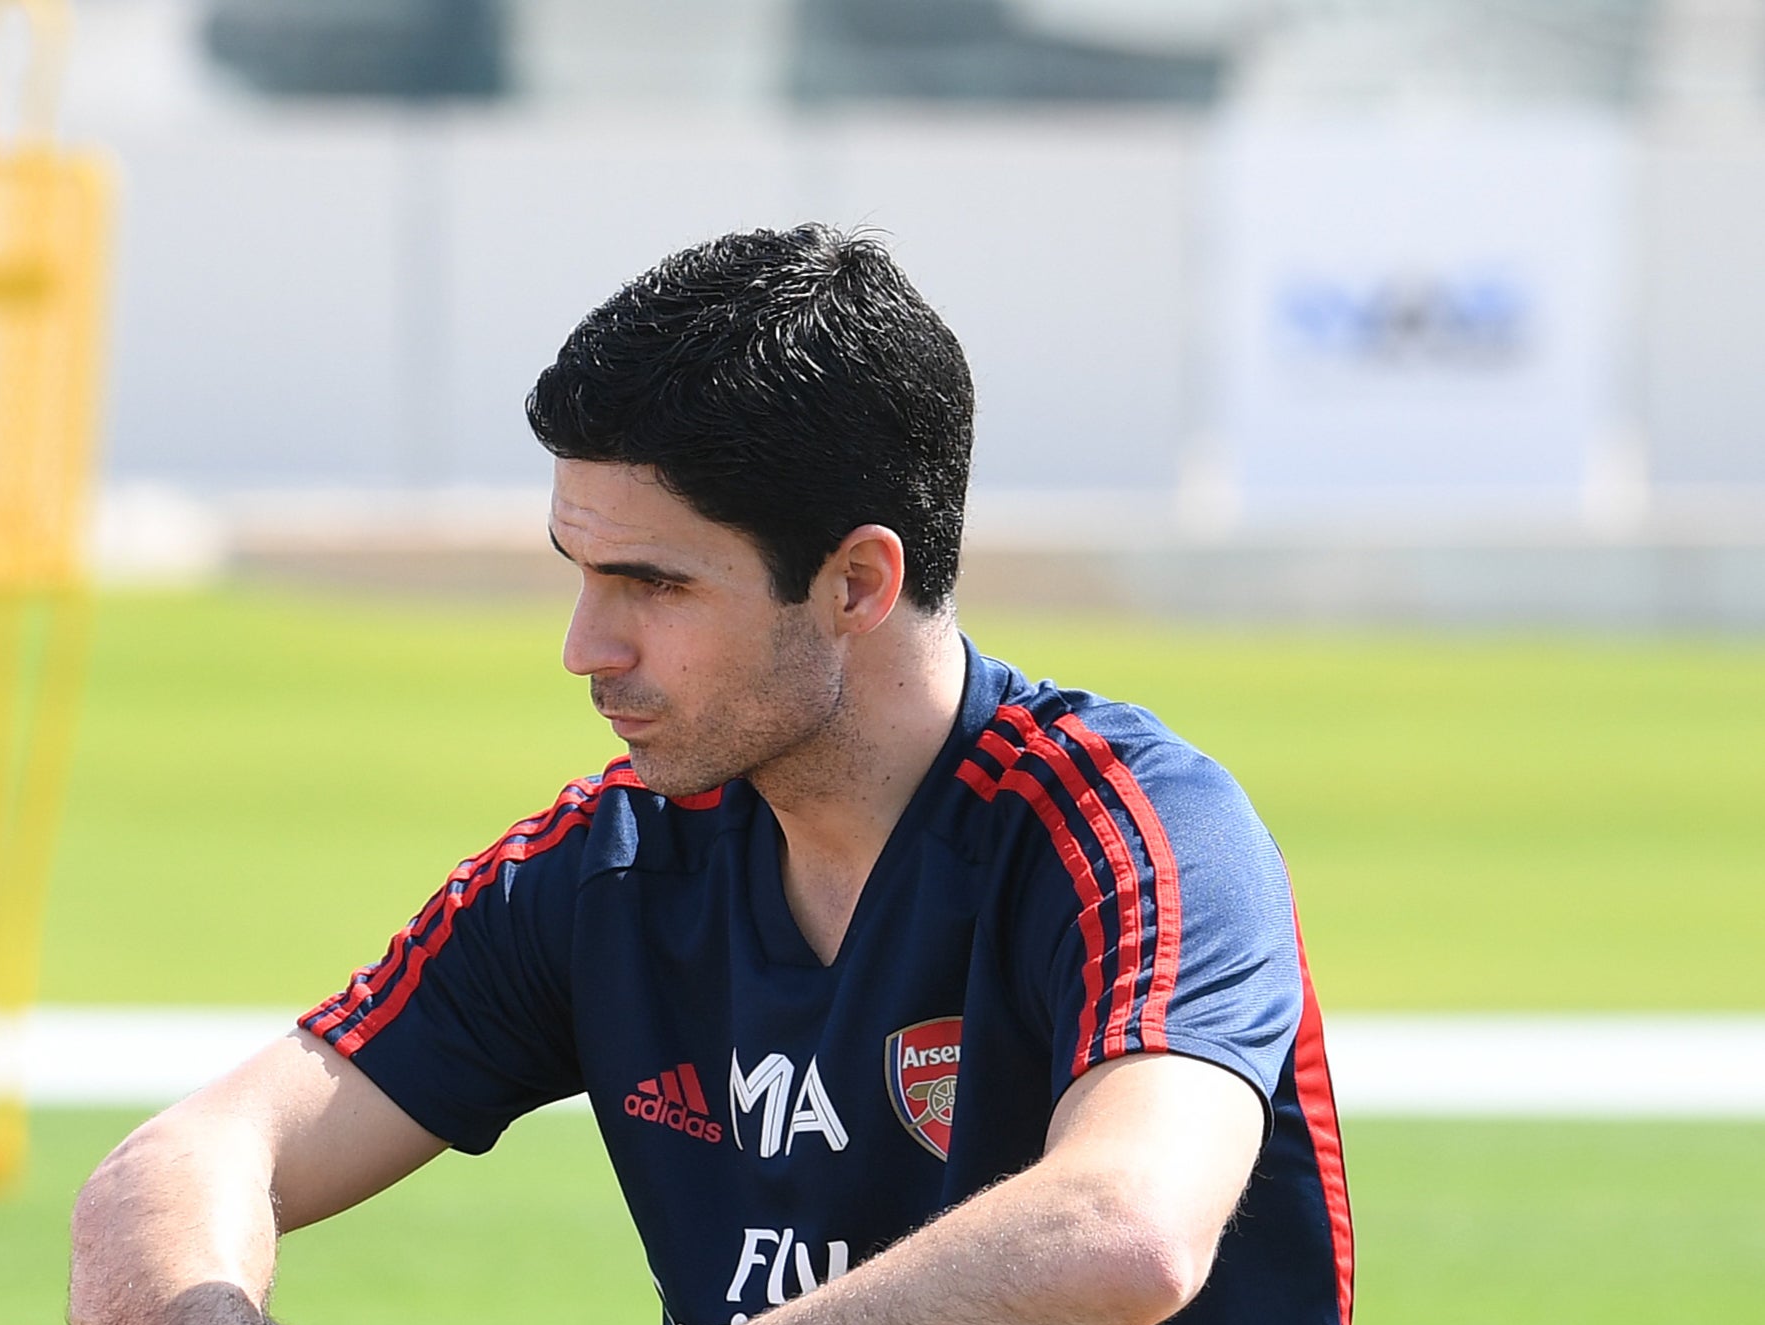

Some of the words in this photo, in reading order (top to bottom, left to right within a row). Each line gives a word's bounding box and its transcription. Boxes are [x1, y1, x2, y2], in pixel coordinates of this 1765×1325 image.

[902, 1045, 962, 1070] Arse
[623, 1094, 723, 1143] adidas
[728, 1047, 850, 1158] MA
